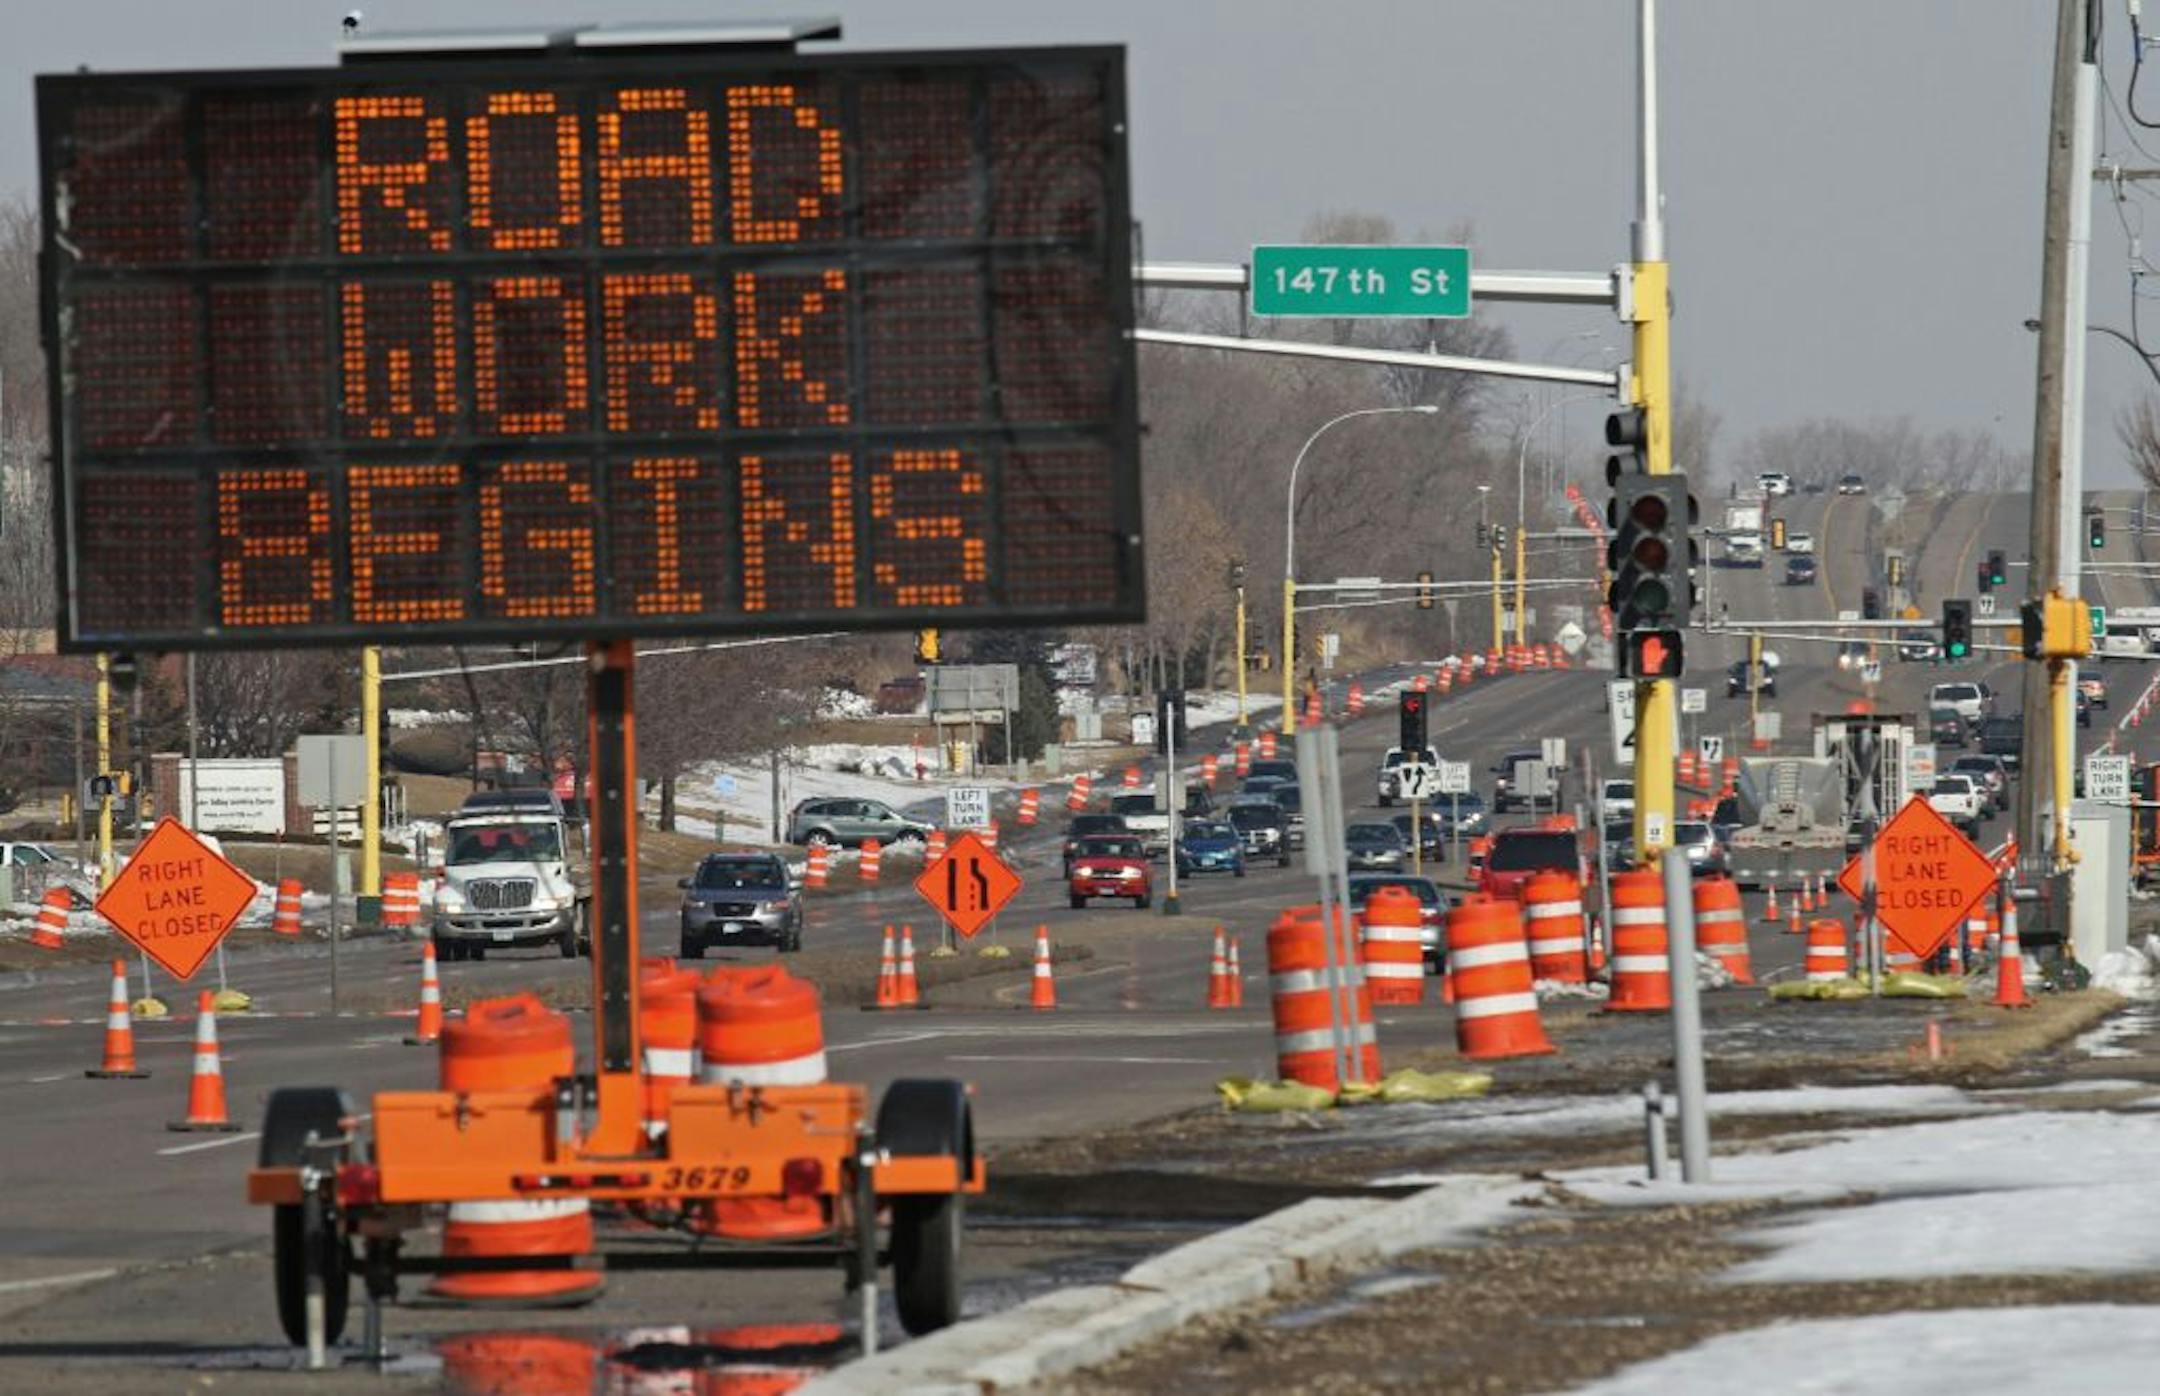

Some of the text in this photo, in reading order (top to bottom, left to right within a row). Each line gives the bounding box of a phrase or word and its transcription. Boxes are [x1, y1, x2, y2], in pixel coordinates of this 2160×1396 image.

[337, 87, 841, 252] ROAD
[1274, 266, 1450, 296] 147th St
[345, 271, 847, 436] WORK
[221, 450, 984, 624] BEGINS
[2090, 761, 2123, 772] RIGHT
[2092, 774, 2123, 783] TURN
[953, 802, 984, 813] TURN
[954, 790, 981, 801] LEFT
[1886, 835, 1951, 855] RIGHT
[138, 858, 206, 882] RIGHT
[1890, 861, 1949, 882] LANE
[145, 886, 207, 912] LANE
[137, 912, 223, 941] CLOSED
[661, 1166, 751, 1191] 3679
